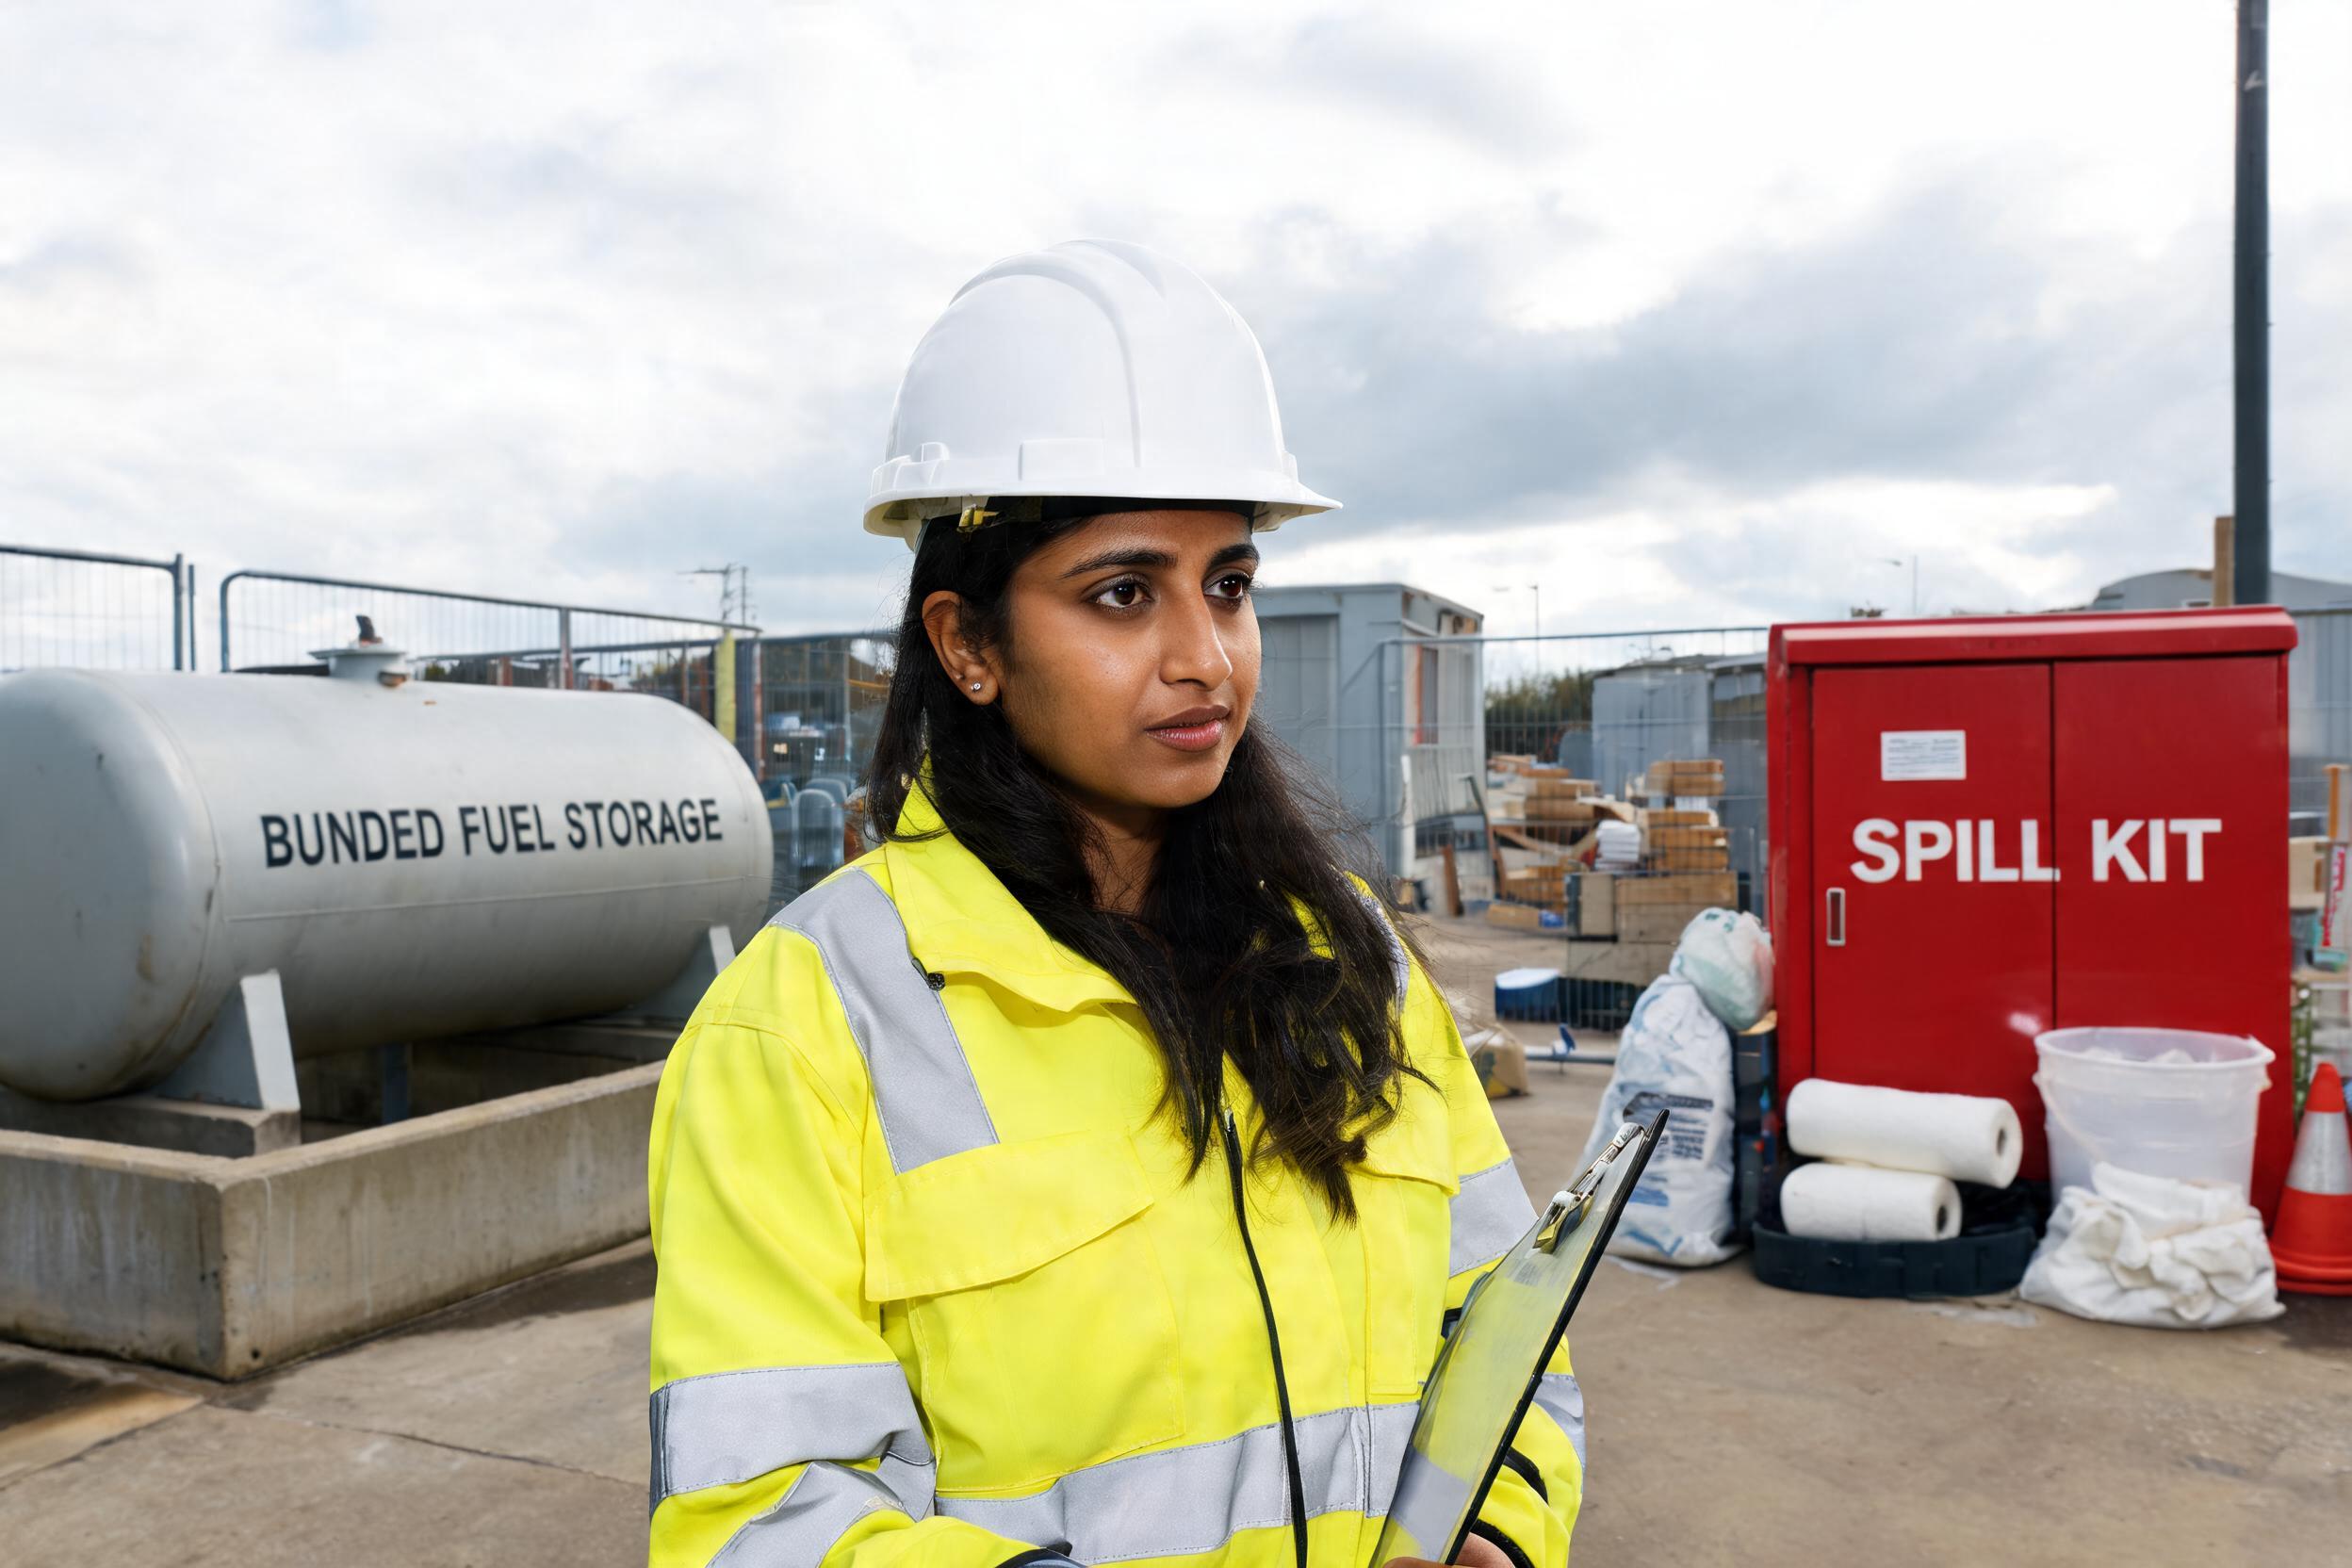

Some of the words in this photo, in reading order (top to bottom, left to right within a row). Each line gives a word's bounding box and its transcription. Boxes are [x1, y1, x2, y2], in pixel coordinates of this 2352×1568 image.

[261, 808, 444, 868] BUNDED
[459, 805, 556, 857] FUEL
[564, 798, 724, 850] STORAGE
[1850, 818, 2061, 884] SPILL
[2091, 818, 2223, 883] KIT
